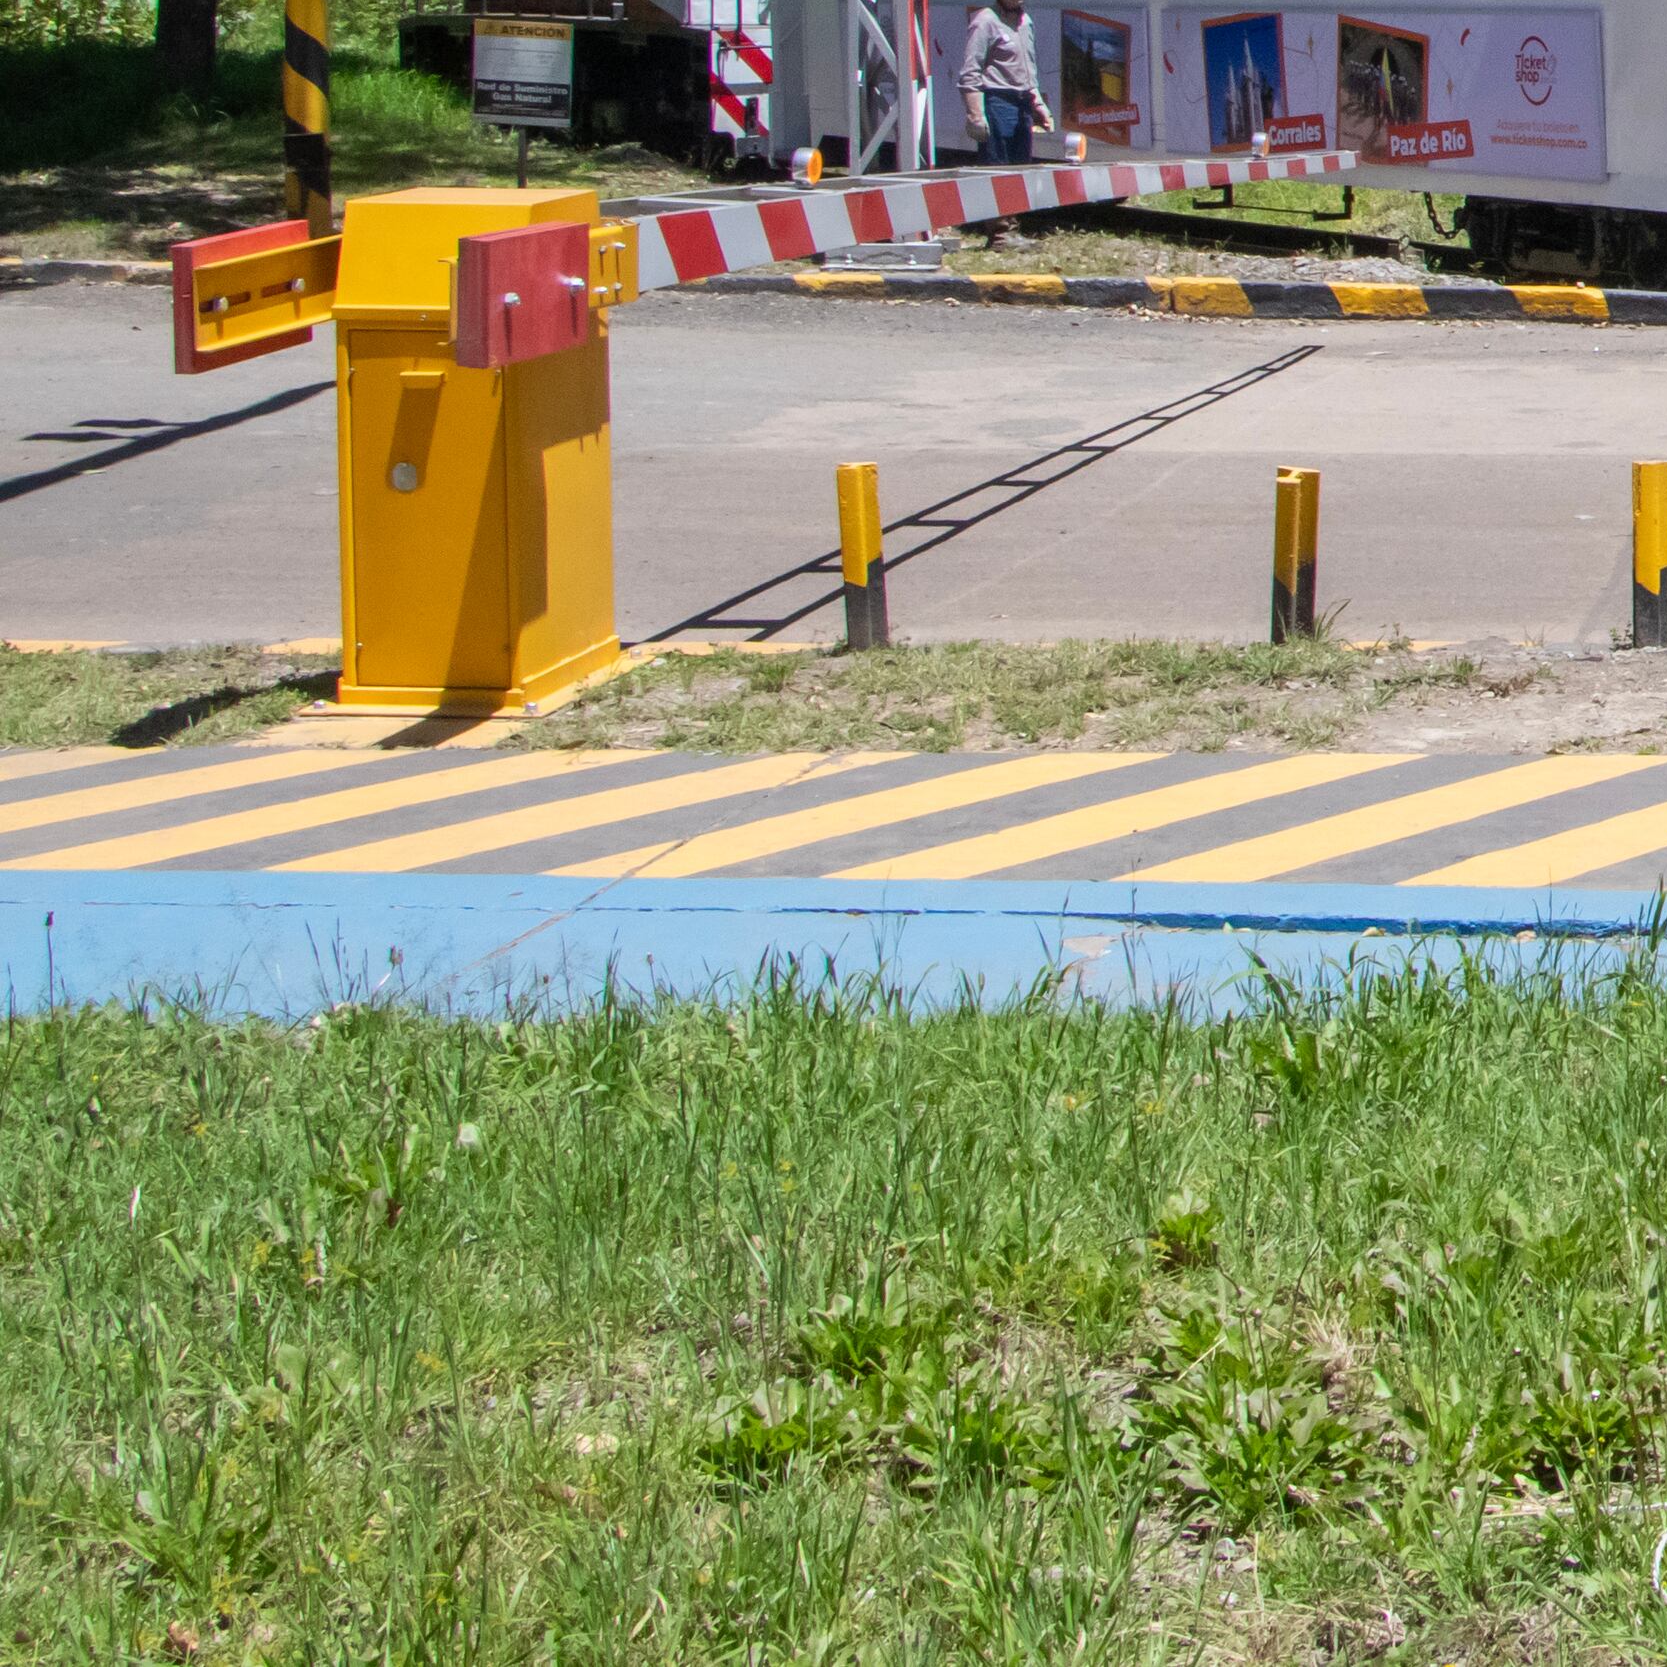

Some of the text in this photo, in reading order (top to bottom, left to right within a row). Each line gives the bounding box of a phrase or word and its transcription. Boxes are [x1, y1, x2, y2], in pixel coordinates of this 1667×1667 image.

[1514, 53, 1547, 71] Ticket
[1515, 69, 1540, 86] shop
[477, 81, 568, 95] Red de Suministro
[493, 92, 552, 103] Gas Natural
[1269, 122, 1322, 146] Corrales
[1490, 134, 1588, 149] www.ticketshop.com.co
[1390, 129, 1467, 157] Paz de Río
